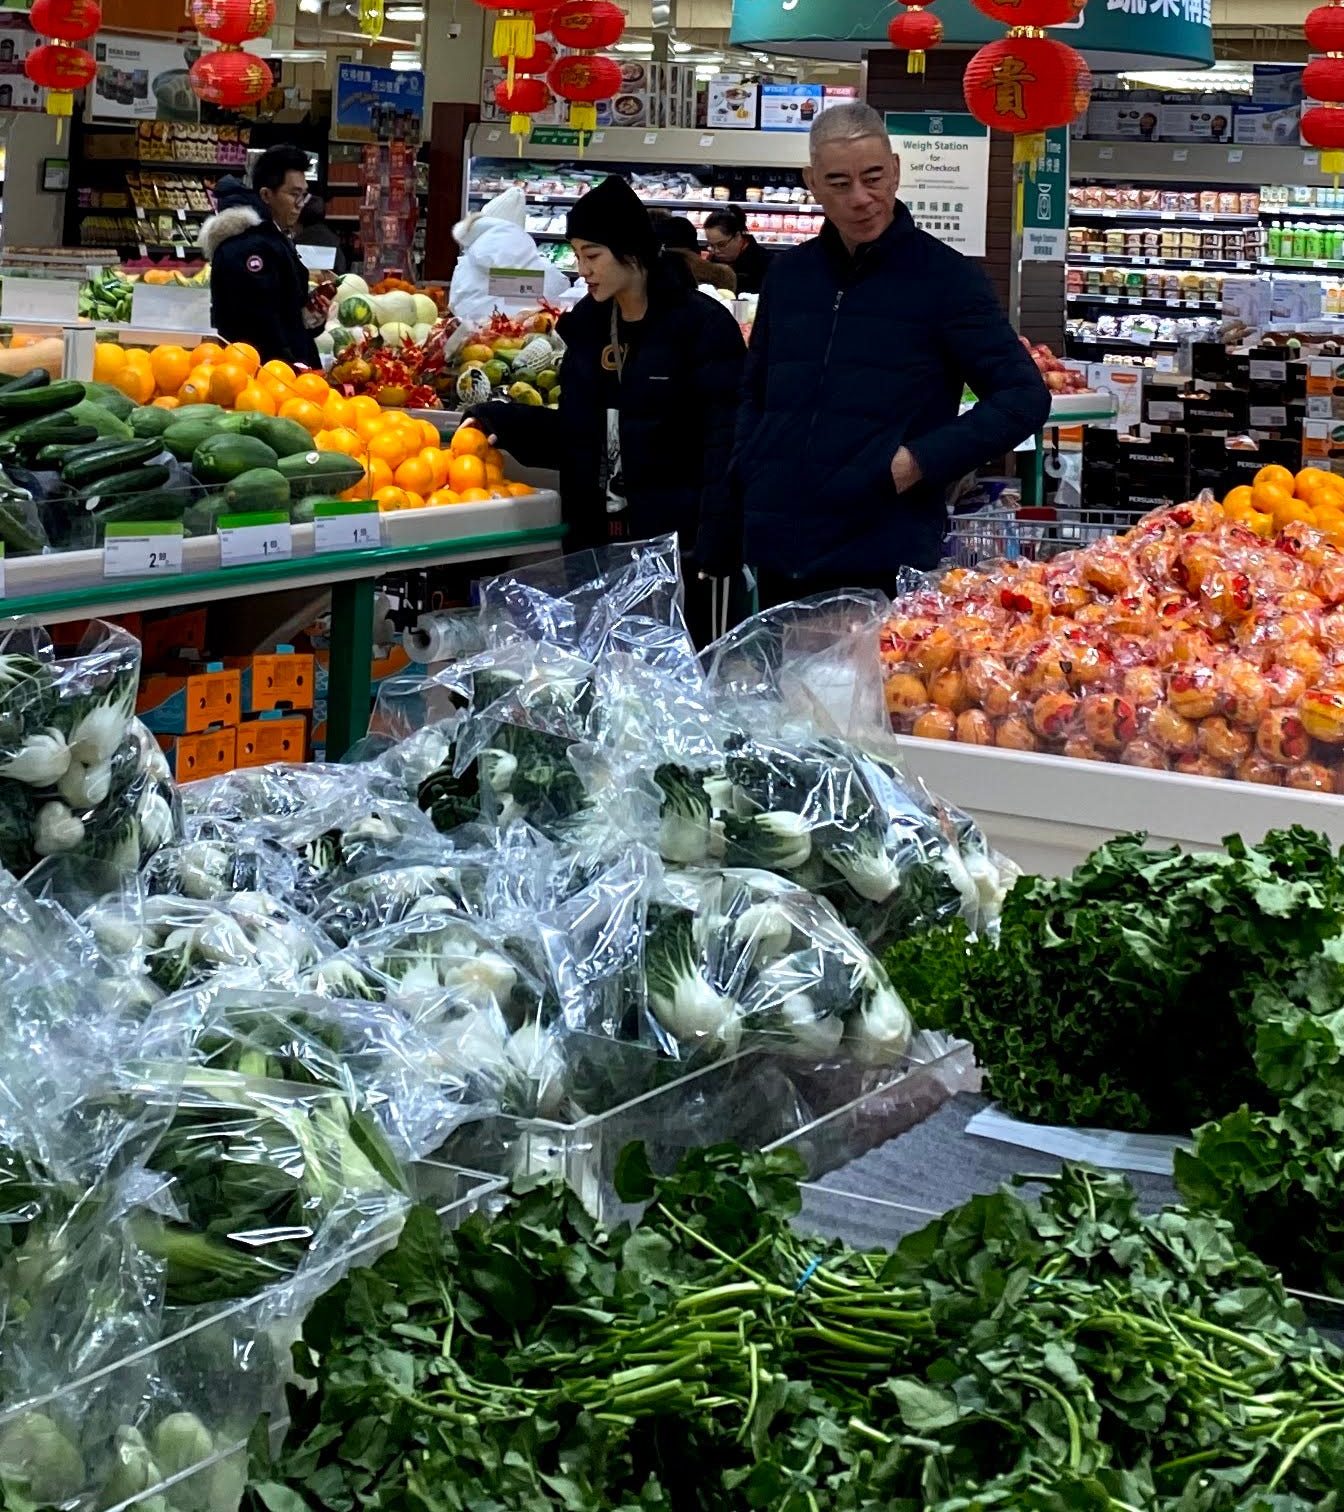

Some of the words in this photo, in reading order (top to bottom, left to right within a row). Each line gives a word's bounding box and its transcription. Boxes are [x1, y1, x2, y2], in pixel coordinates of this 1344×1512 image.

[903, 140, 932, 153] Weigh
[934, 141, 969, 151] Station
[929, 154, 941, 162] for
[910, 163, 924, 172] Self
[925, 163, 960, 173] Checkout
